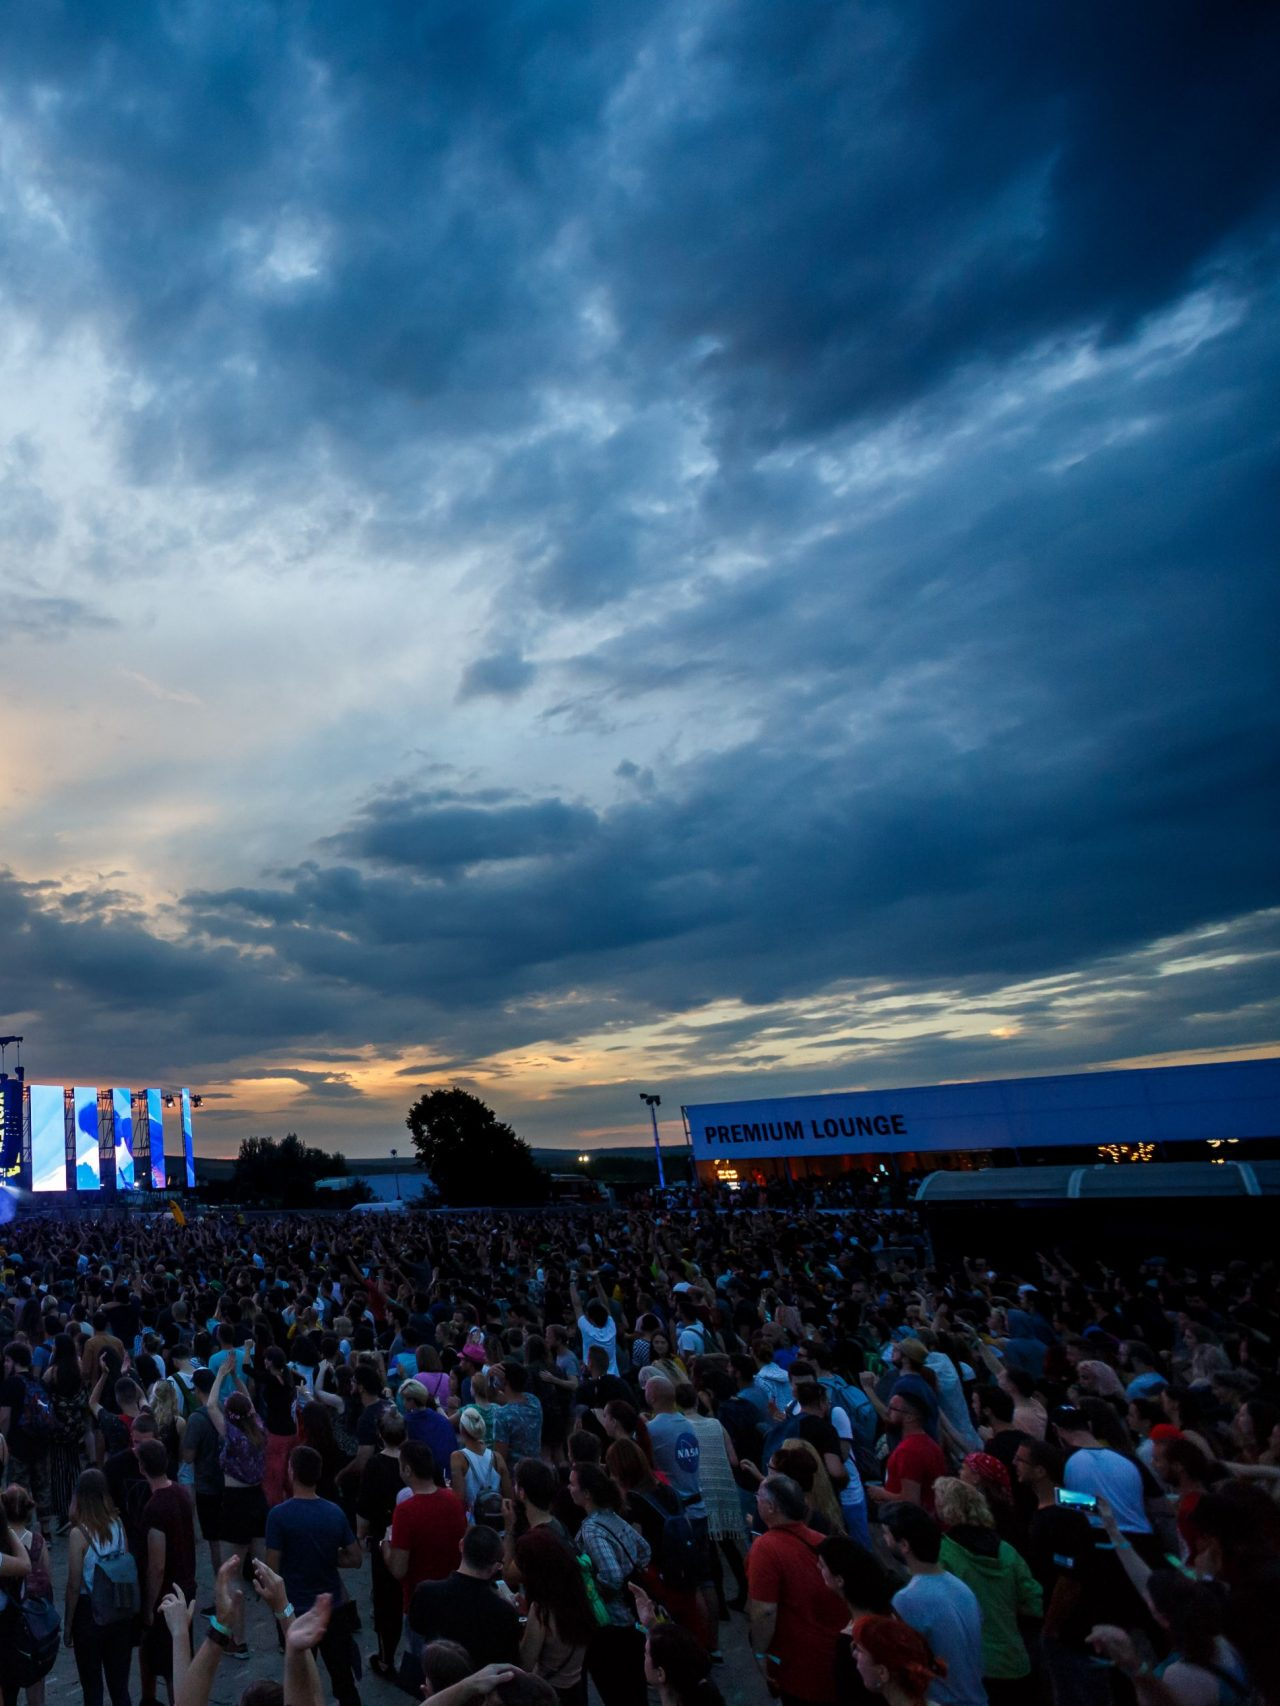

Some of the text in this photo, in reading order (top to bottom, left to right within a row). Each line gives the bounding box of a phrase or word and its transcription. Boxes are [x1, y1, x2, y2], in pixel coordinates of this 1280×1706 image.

[705, 1114, 908, 1145] PREMIUM LOUNGE
[677, 1447, 699, 1459] NASA
